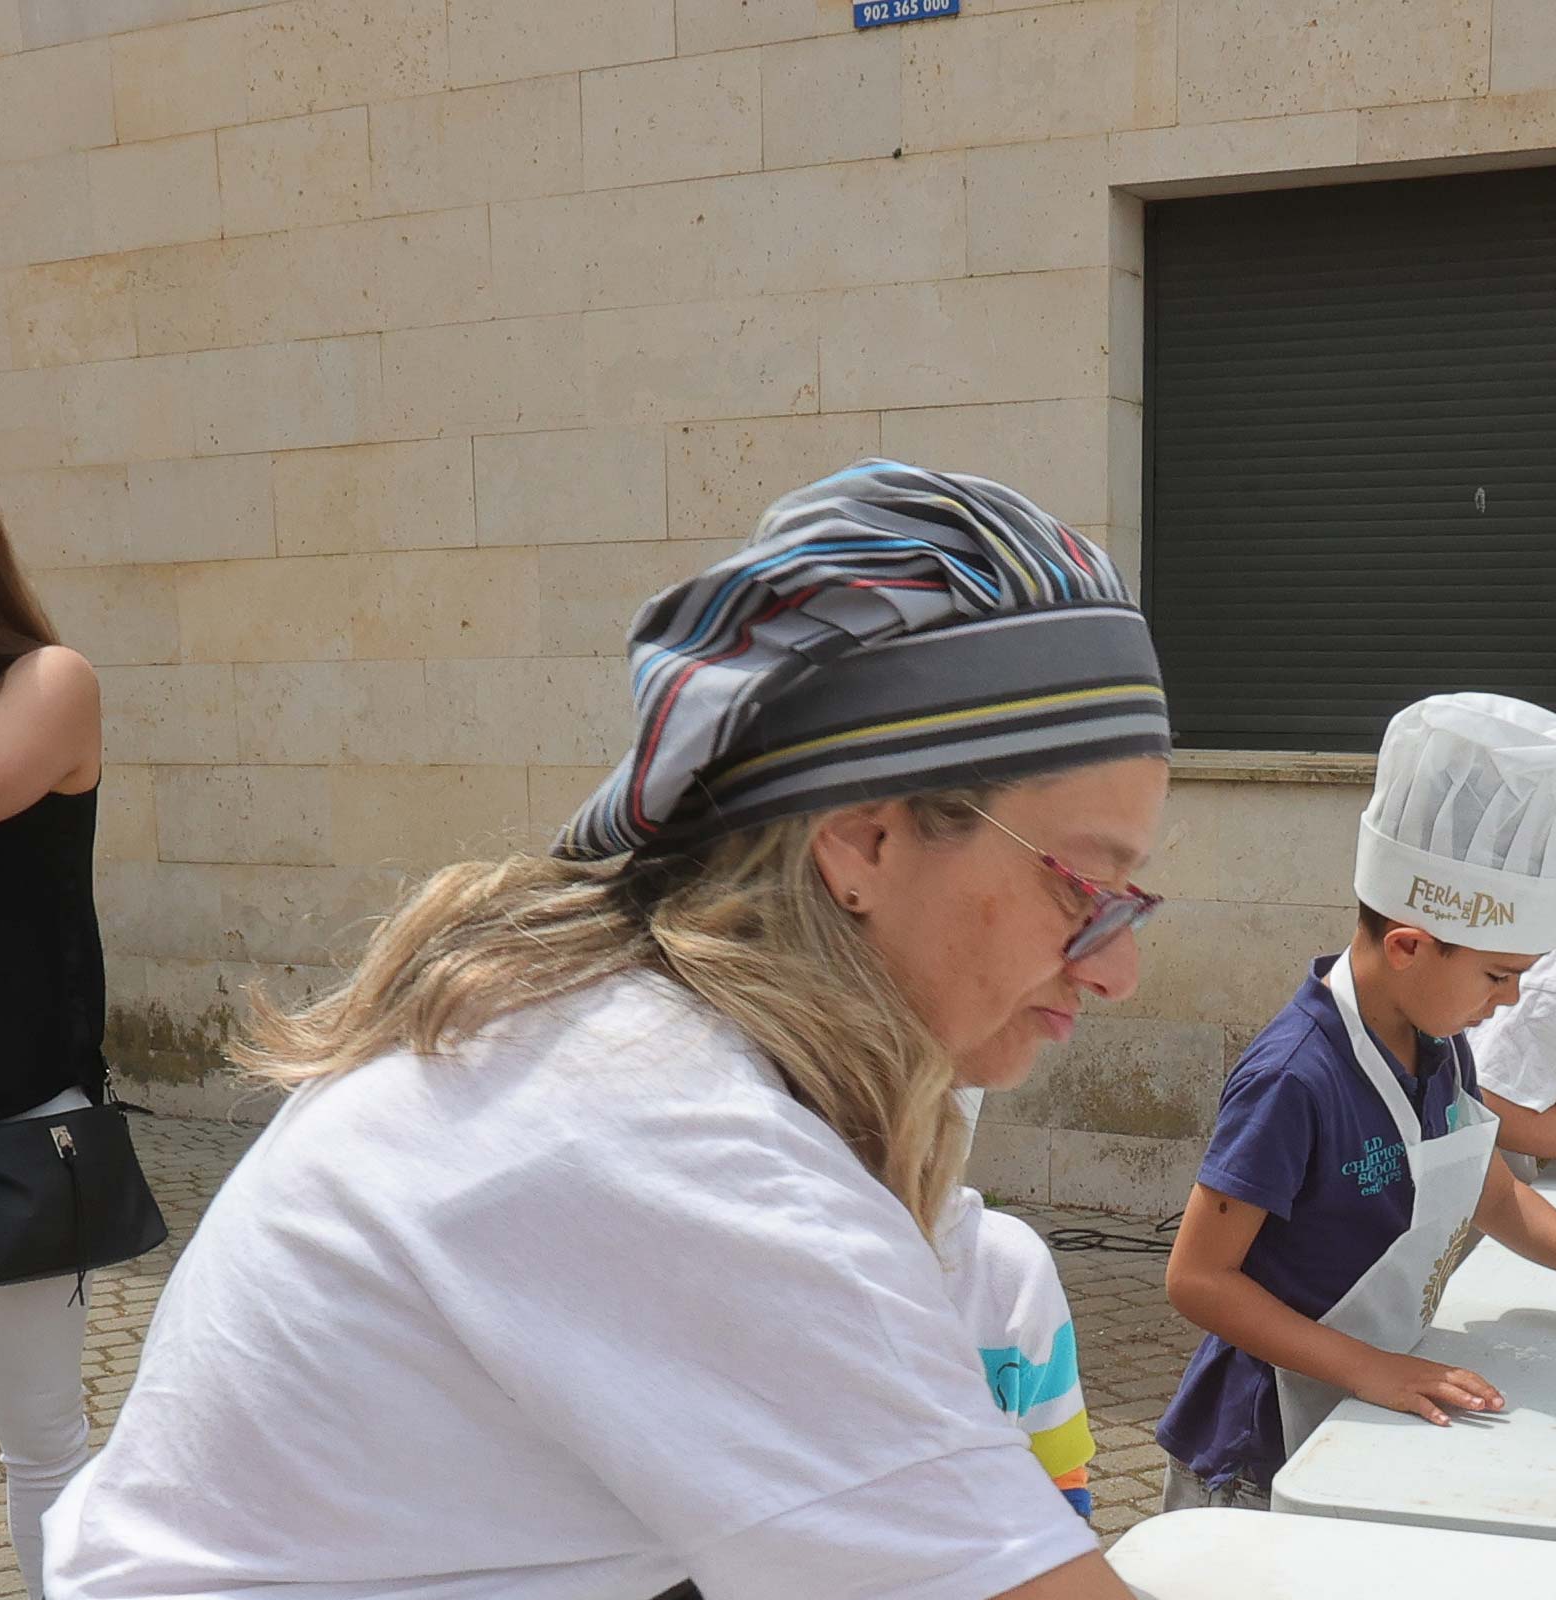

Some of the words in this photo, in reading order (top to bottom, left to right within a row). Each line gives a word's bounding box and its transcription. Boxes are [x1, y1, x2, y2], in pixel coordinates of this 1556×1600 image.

[864, 3, 889, 22] 902
[893, 0, 919, 17] 365
[923, 0, 950, 12] 000
[1404, 875, 1462, 910] FERIA
[1466, 890, 1515, 928] PAN
